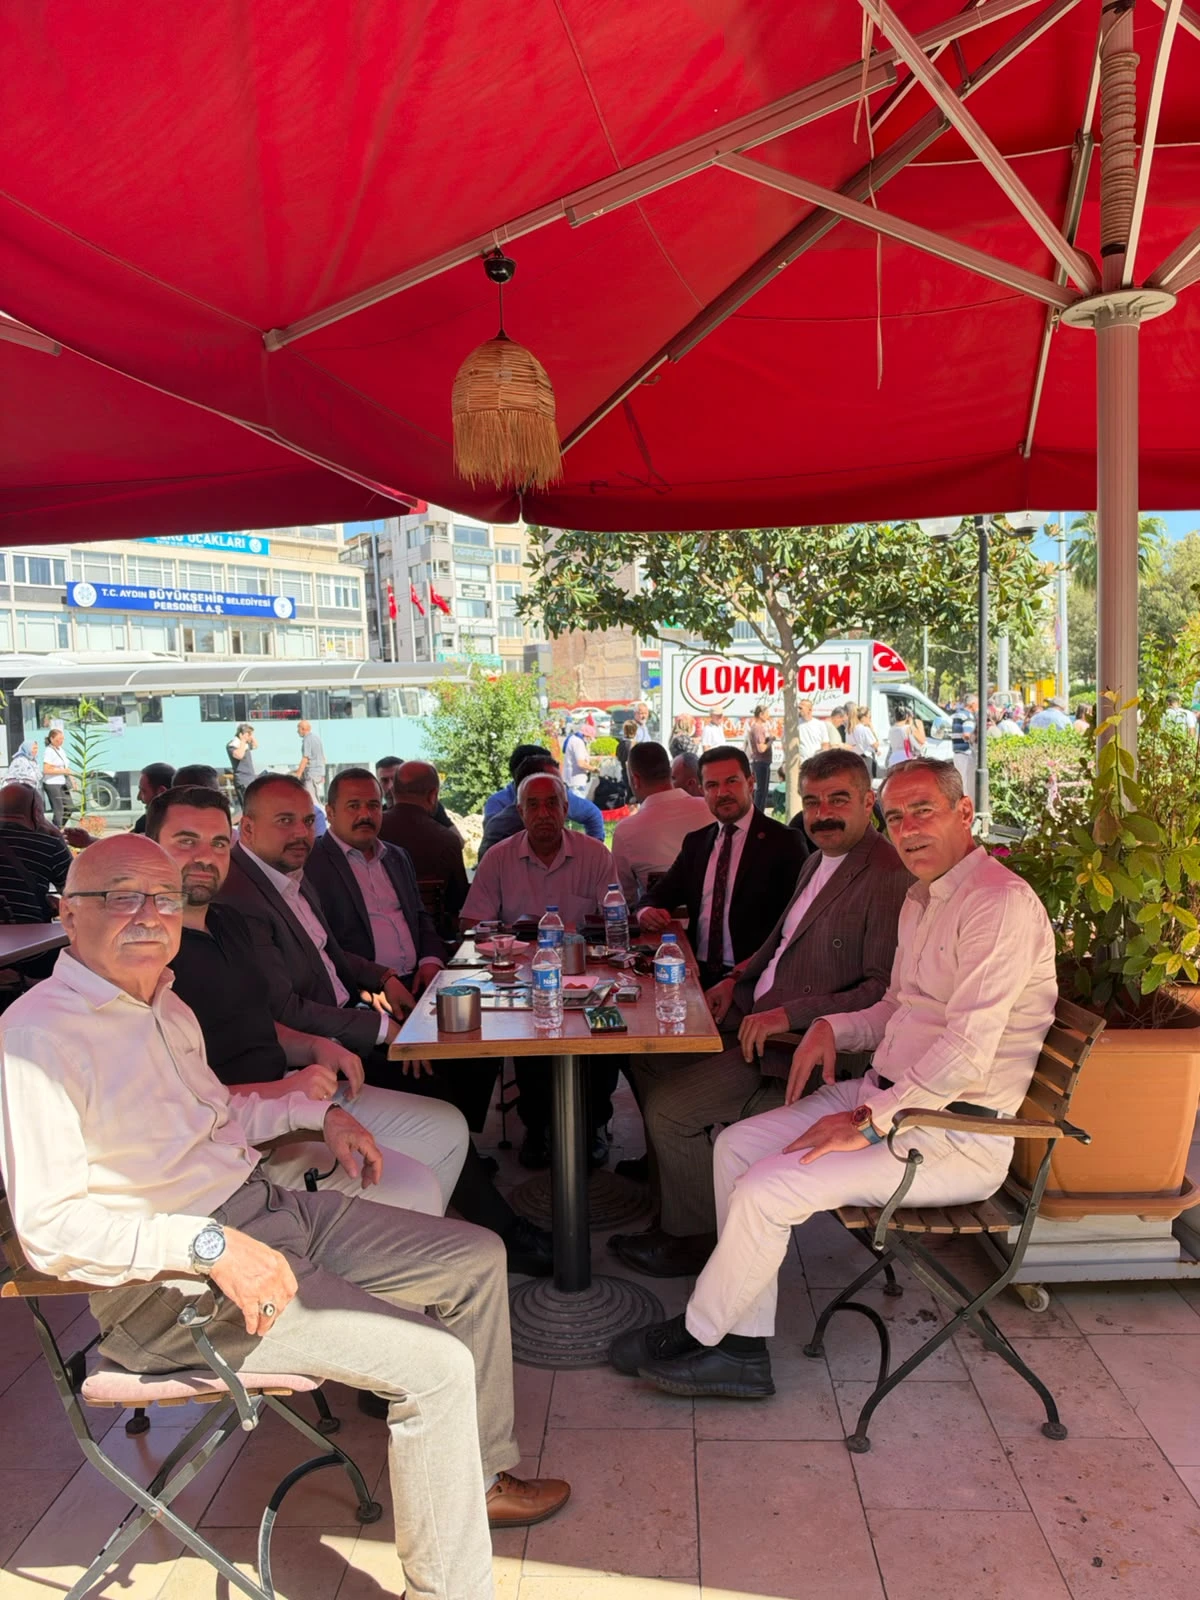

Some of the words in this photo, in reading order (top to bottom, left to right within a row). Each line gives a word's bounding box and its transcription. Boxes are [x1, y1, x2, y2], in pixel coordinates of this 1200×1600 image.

[101, 588, 118, 597] T.C.
[120, 589, 147, 599] AYDIN
[148, 588, 224, 605] BÜYÜKŞEHİR
[226, 597, 271, 608] BELEDİYESİ
[154, 601, 204, 612] PERSONEL
